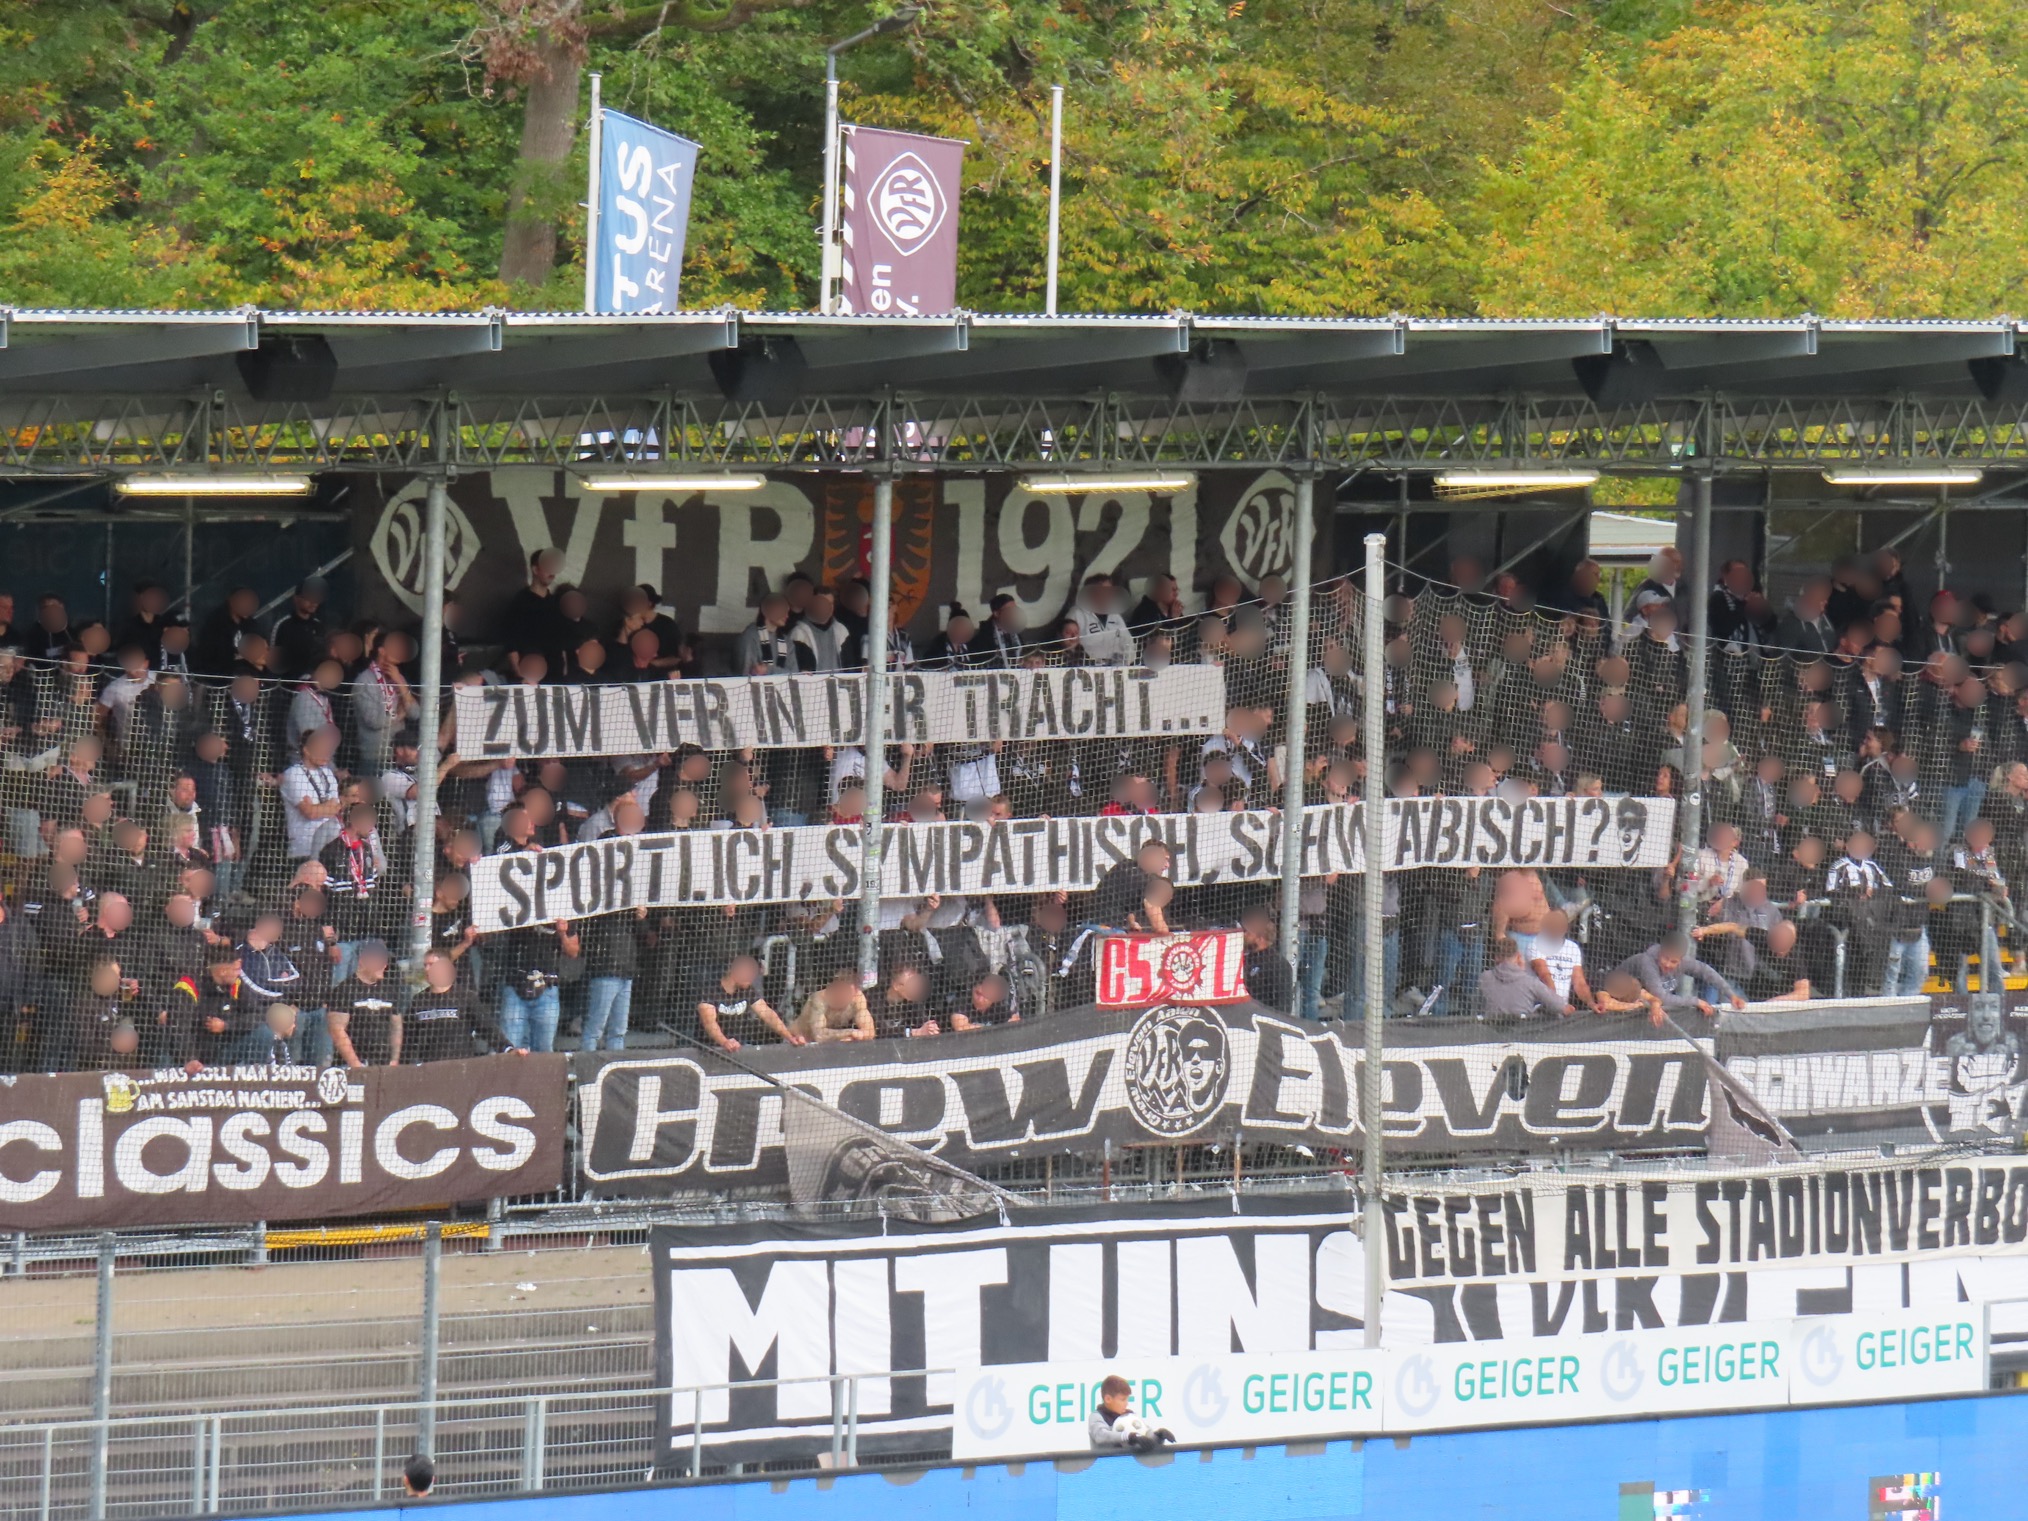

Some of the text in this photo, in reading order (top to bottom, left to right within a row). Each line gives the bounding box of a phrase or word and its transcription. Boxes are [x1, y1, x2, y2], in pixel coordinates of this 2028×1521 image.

[611, 141, 652, 310] TUS
[938, 478, 1201, 630] 1921
[482, 683, 602, 756] ZUM
[749, 676, 807, 745] IN
[825, 674, 928, 743] DR
[953, 667, 1209, 740] TRACHT...
[498, 830, 814, 927] SPORTLICH,
[137, 1092, 165, 1111] AM
[167, 1089, 236, 1110] SAMSTAG
[1241, 1014, 1712, 1136] Eleven
[0, 1085, 536, 1203] classics
[1382, 1187, 1537, 1281] GEGEN
[1564, 1180, 1670, 1271] ALLE
[670, 1246, 1008, 1426] MIT
[1454, 1355, 1581, 1402] GEIGER
[1657, 1340, 1781, 1387] GEIGER
[1855, 1321, 1975, 1371] GEIGER
[1242, 1370, 1373, 1415] GEIGER
